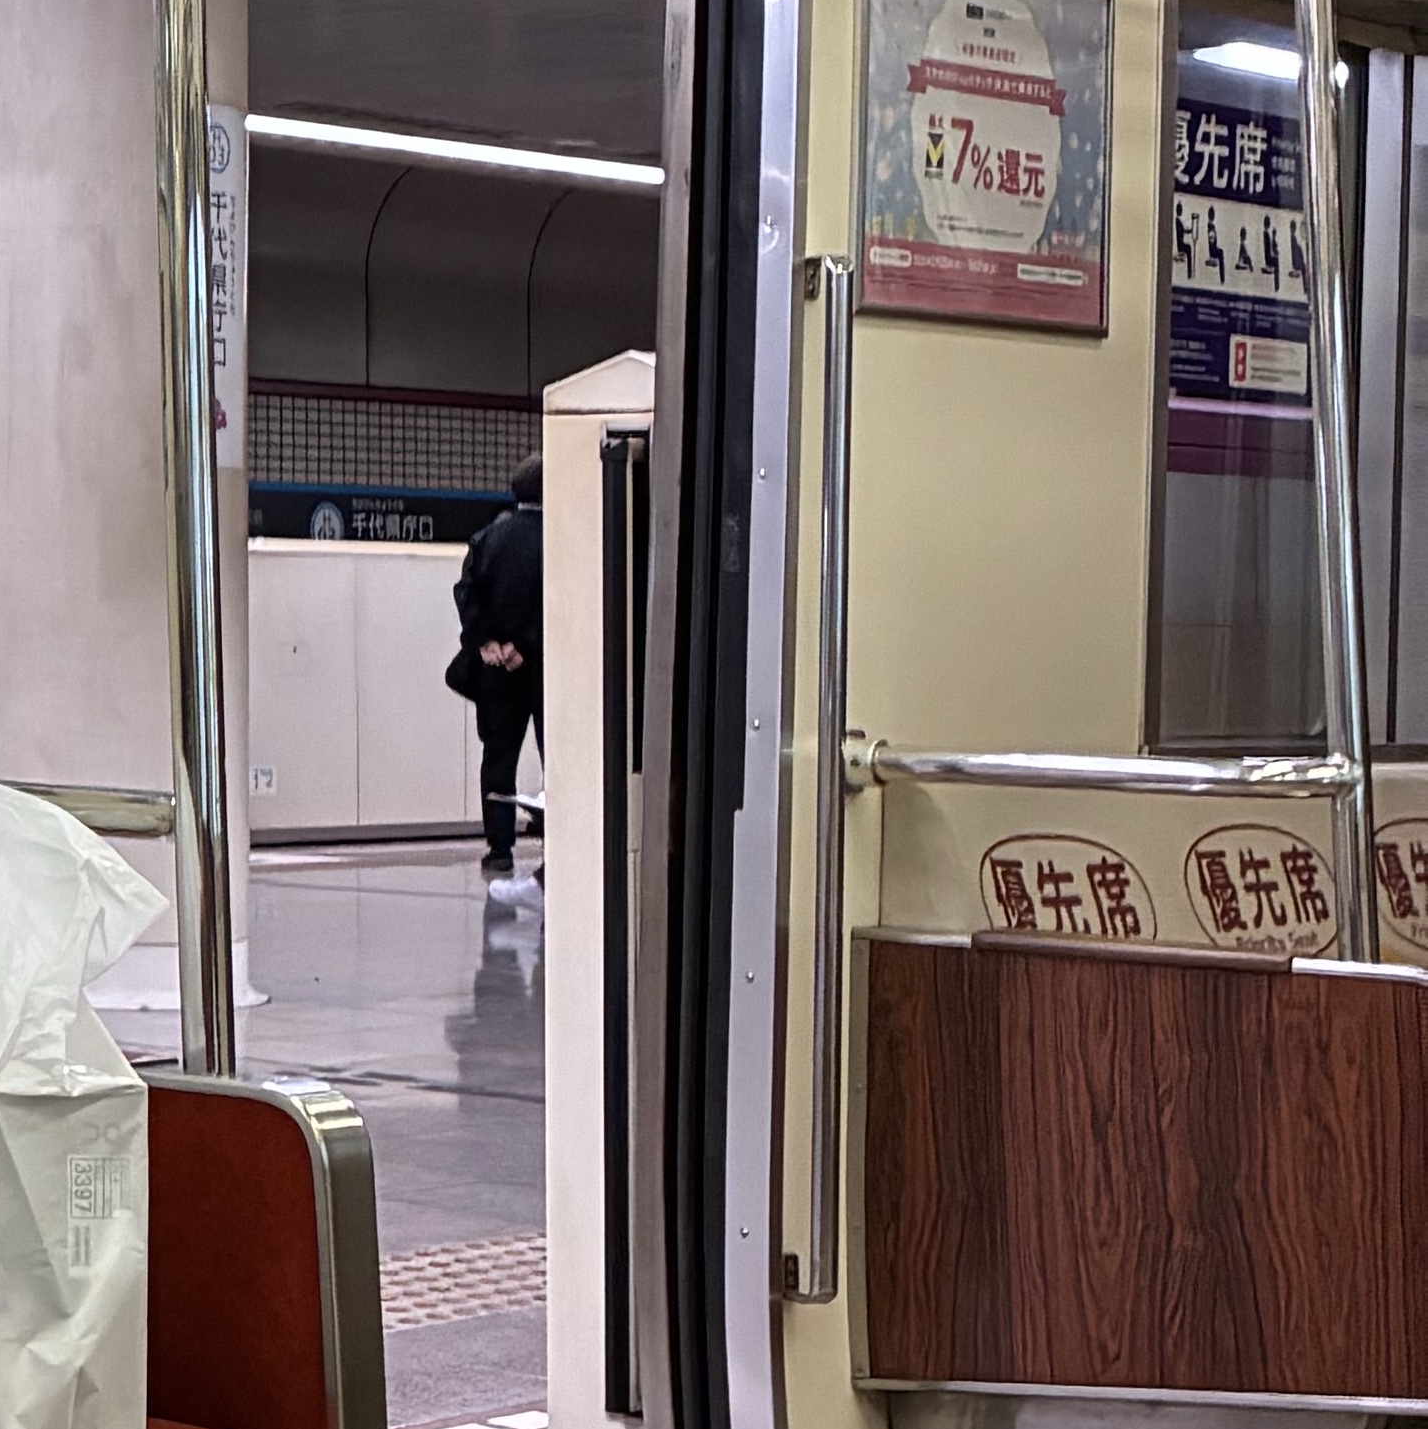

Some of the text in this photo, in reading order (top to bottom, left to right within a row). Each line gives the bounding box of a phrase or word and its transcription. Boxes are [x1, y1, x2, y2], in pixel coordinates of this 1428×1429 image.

[989, 855, 1143, 938] 優先席
[1194, 843, 1331, 934] 優先席
[73, 1162, 93, 1214] 3397
